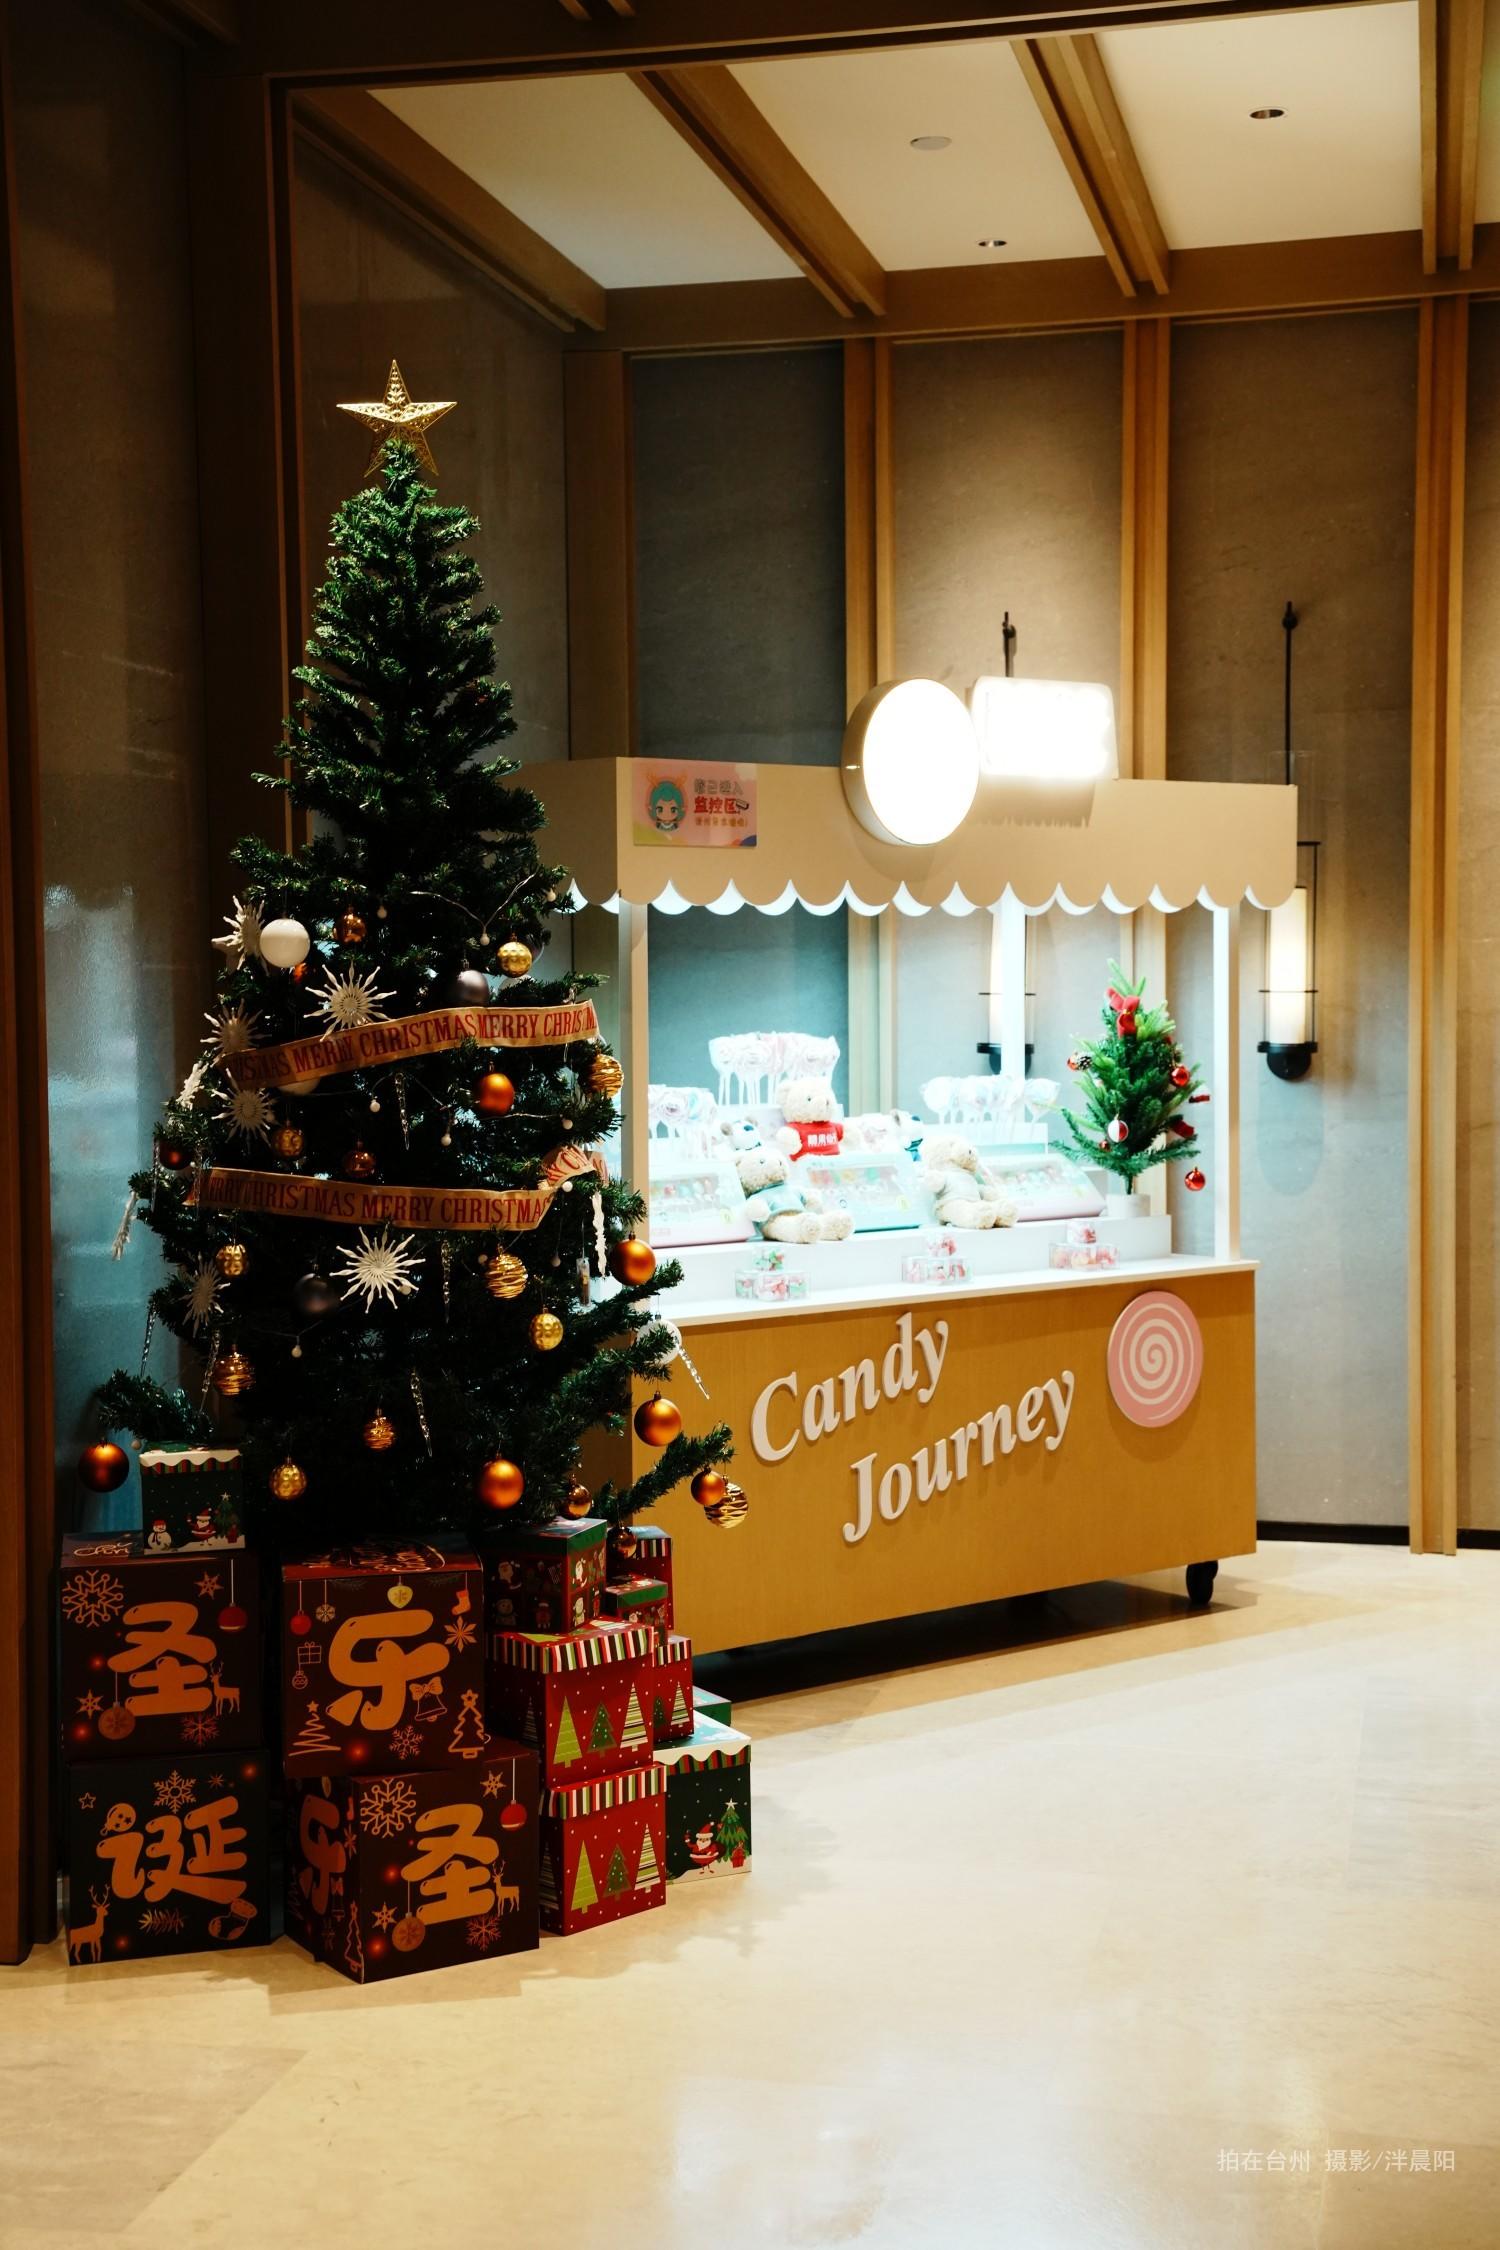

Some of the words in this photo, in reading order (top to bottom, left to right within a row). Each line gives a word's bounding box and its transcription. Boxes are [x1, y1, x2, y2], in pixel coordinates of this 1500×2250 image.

[694, 796, 740, 814] 监控区
[293, 1034, 354, 1073] MERRY
[359, 1015, 478, 1059] CHRISTMAS
[478, 1014, 539, 1039] MERRY
[361, 1194, 434, 1223] MERRY
[750, 1311, 949, 1462] Candy
[842, 1370, 1075, 1543] Journey
[107, 1601, 218, 1717] 圣
[325, 1609, 450, 1731] 乐
[96, 1796, 248, 1902] 诞
[400, 1803, 500, 1925] 圣
